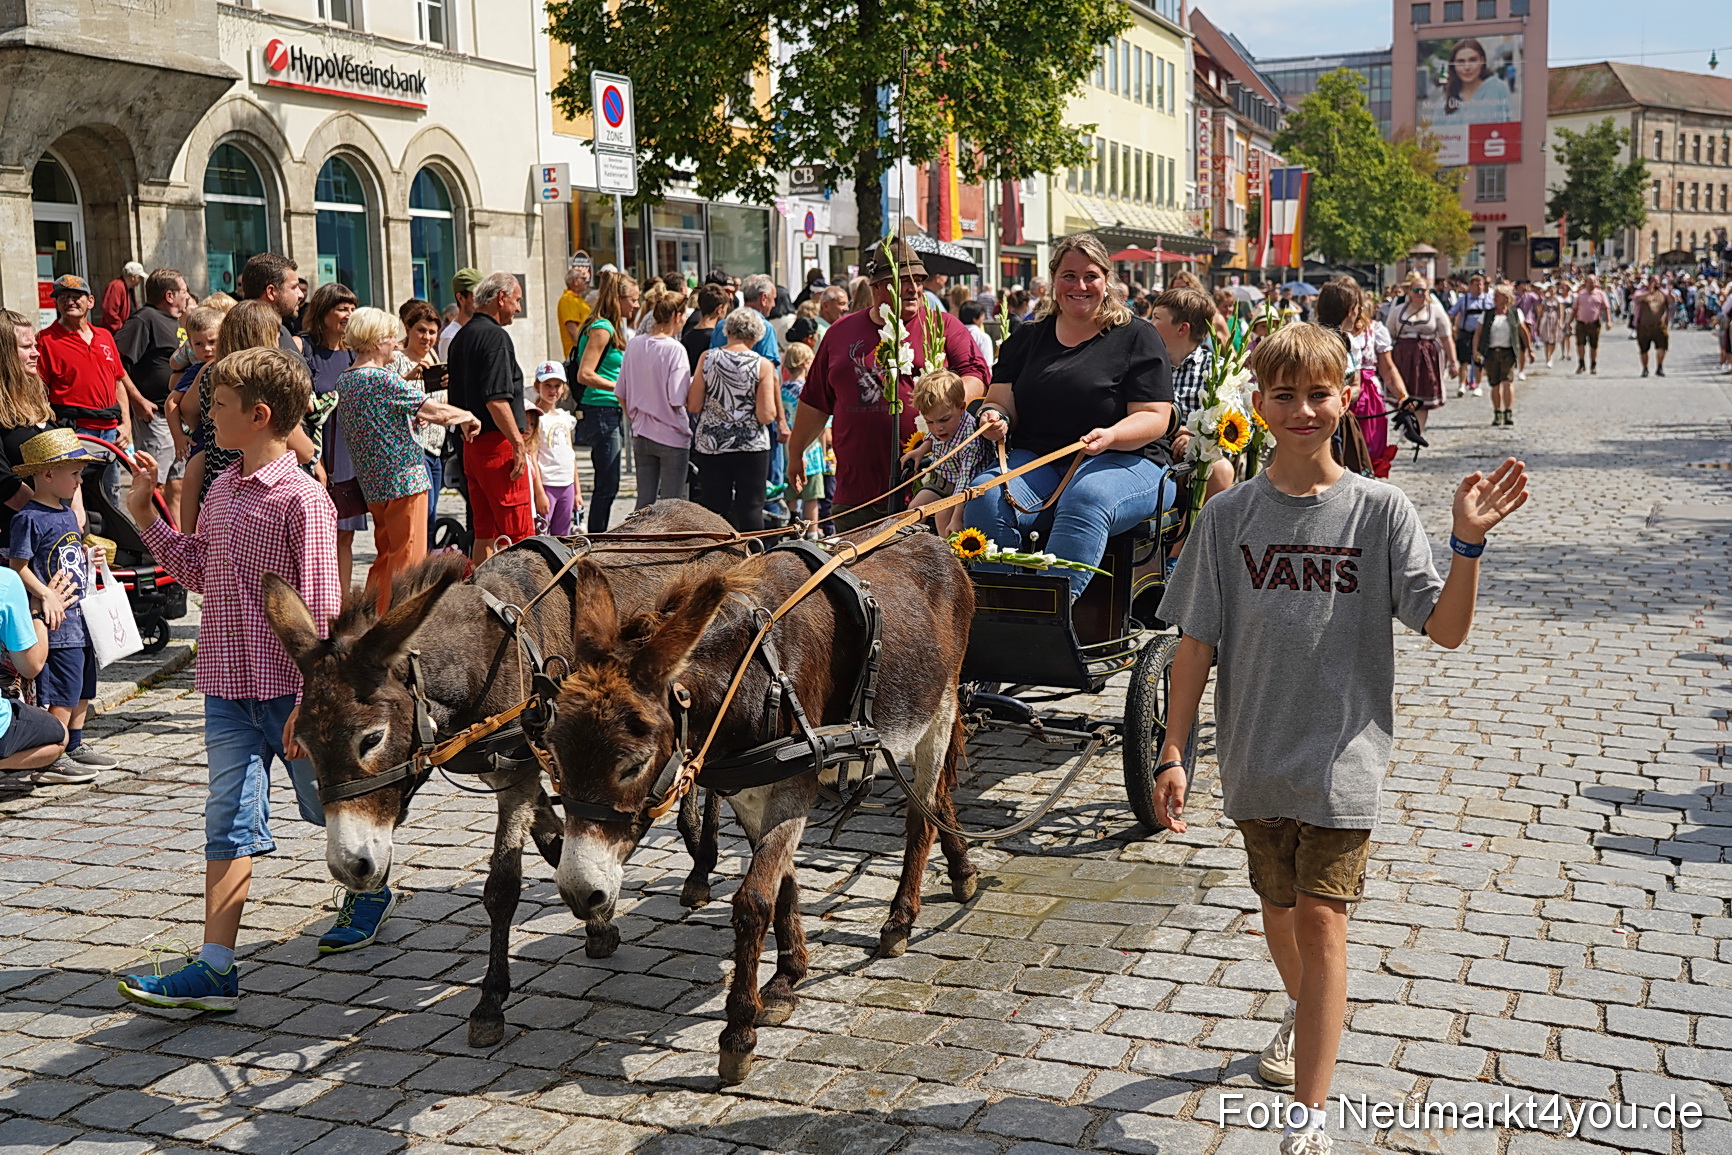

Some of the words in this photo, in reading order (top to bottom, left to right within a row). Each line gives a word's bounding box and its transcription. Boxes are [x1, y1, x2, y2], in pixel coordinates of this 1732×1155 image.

[291, 44, 428, 95] HypoVereinsbank
[606, 130, 624, 143] ZONE
[790, 166, 815, 185] CB
[1239, 544, 1362, 594] VANS
